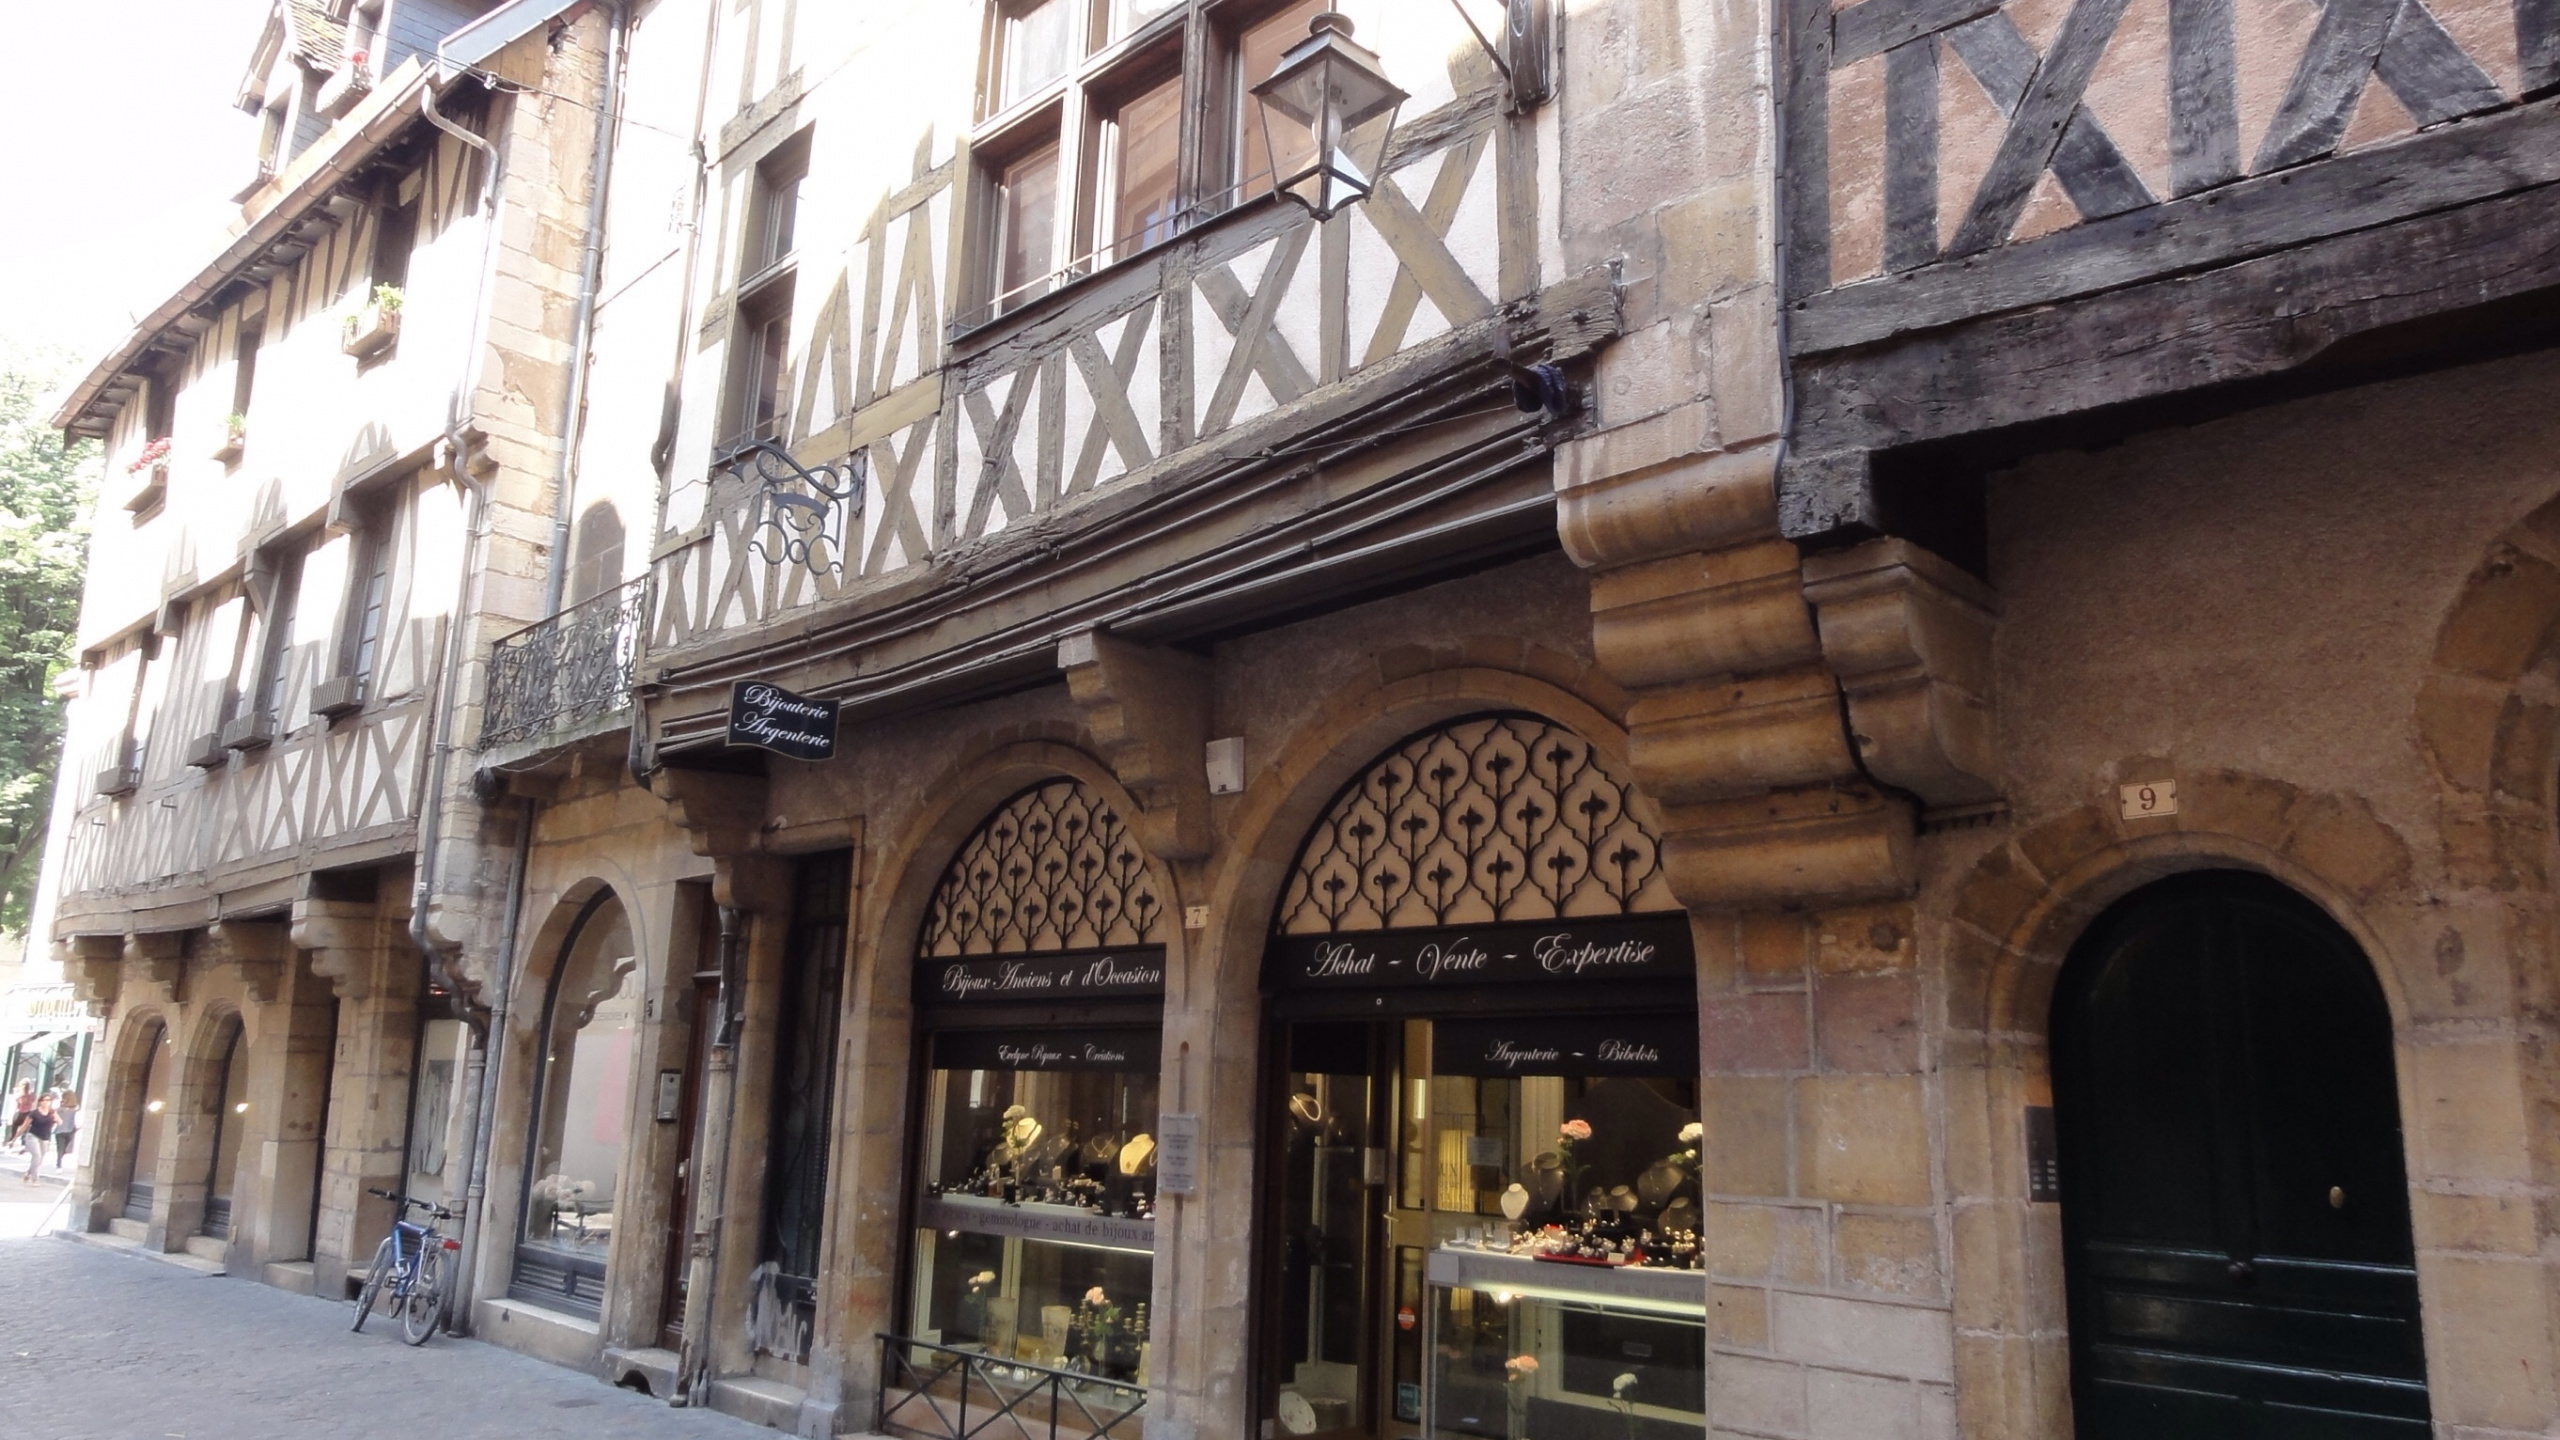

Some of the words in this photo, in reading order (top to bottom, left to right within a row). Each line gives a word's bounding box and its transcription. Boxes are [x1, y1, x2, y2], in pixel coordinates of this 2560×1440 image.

[743, 684, 829, 719] Bijouterie
[734, 711, 830, 748] Argenterie
[2139, 787, 2156, 810] 9
[1193, 908, 1201, 924] 7
[1306, 941, 1376, 977] Achat
[1416, 937, 1488, 980] Vente
[1533, 933, 1655, 974] Expertise
[942, 964, 991, 999] Bijoux
[993, 961, 1053, 990] Anciens
[1059, 970, 1074, 987] et
[1081, 957, 1160, 986] d'Occasion
[1484, 1039, 1560, 1069] Argenterie
[1597, 1039, 1658, 1062] Bibelots
[979, 1211, 1041, 1232] gemmologue
[1053, 1217, 1081, 1236] achat
[1085, 1220, 1098, 1236] de
[1102, 1221, 1138, 1242] bijoux
